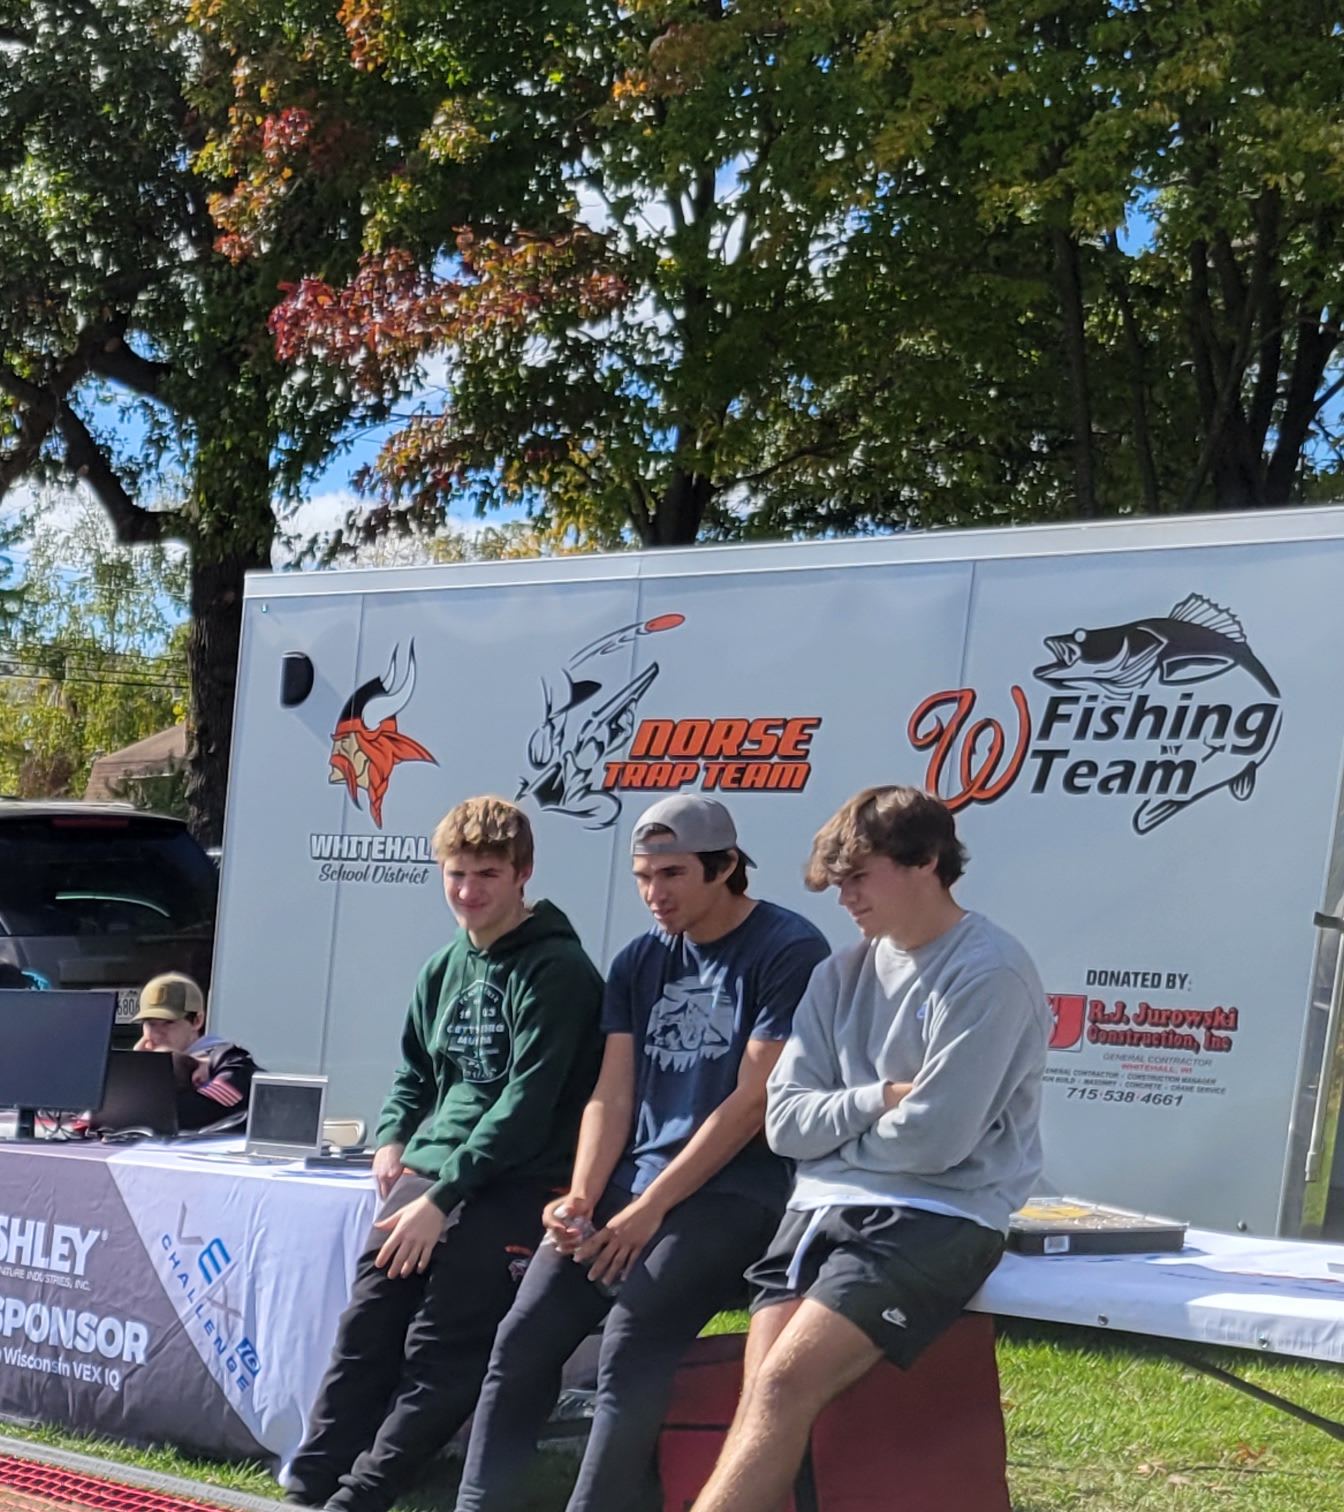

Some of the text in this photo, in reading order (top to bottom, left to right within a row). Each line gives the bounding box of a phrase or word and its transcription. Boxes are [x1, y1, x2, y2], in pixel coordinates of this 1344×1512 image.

[629, 717, 822, 760] NORSE
[1036, 692, 1279, 755] Fishing
[602, 762, 811, 793] TRAP TEAM
[1030, 749, 1198, 795] Team
[318, 863, 430, 884] School District
[1086, 969, 1161, 989] DONATED
[1087, 999, 1238, 1032] R.J. Jurowski
[1086, 1024, 1233, 1054] Construction, Inc
[1045, 1068, 1072, 1076] ENERAL
[1103, 1053, 1212, 1067] GENERAL CONTRACTOR
[161, 1233, 250, 1393] CHALLENGE
[3, 1345, 71, 1378] Wisconsin
[73, 1361, 103, 1385] VEX
[104, 1368, 121, 1392] IQ
